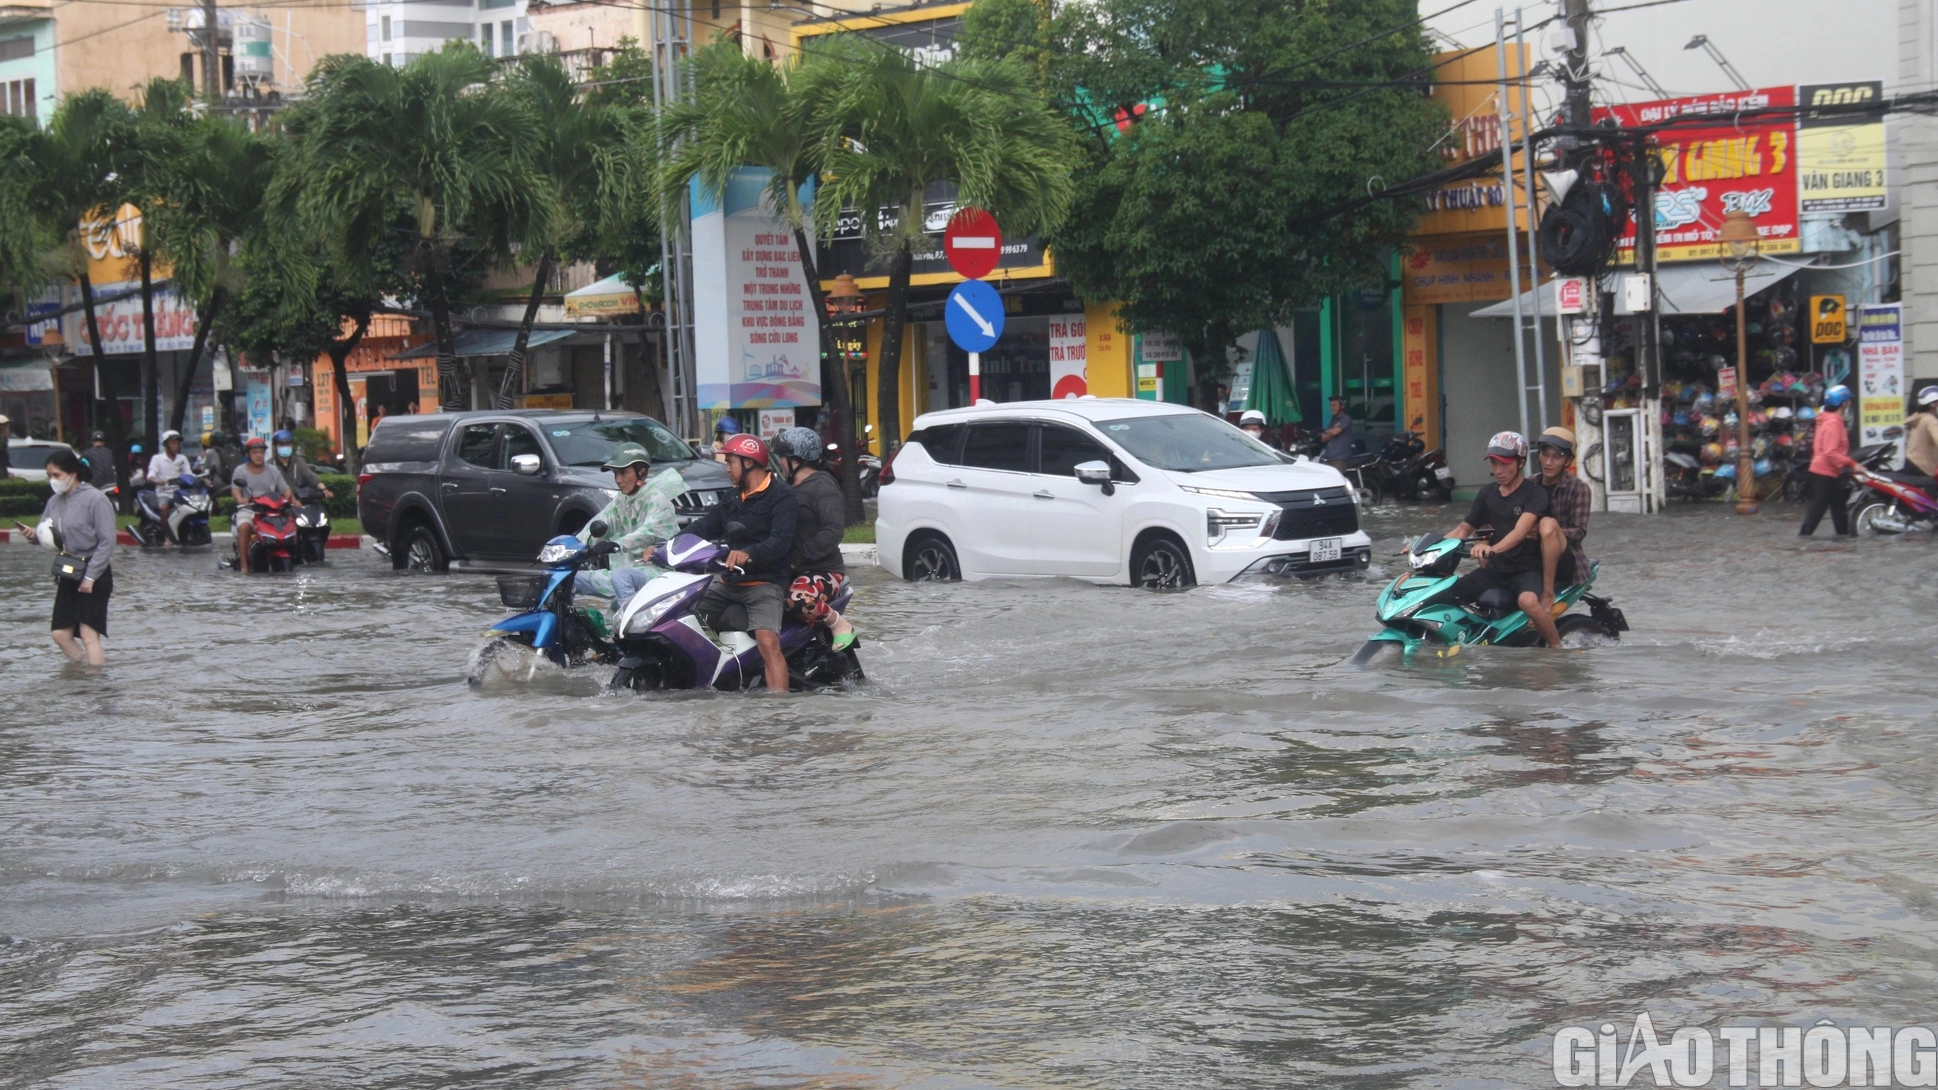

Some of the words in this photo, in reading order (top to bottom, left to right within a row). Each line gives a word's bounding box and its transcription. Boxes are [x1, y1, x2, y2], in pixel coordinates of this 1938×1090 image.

[1686, 136, 1761, 181] GIANG
[1770, 131, 1787, 174] 3
[1832, 171, 1872, 189] GIANG
[1876, 170, 1884, 187] 3
[754, 231, 774, 246] QUYẾT
[775, 232, 789, 245] TÂM
[742, 249, 754, 261] XÂY
[755, 250, 772, 264] DỰNG
[774, 251, 786, 264] BẠC
[755, 264, 767, 278] TRỞ
[769, 265, 789, 278] THÀNH
[744, 282, 757, 297] MỘT
[758, 284, 778, 294] TRONG
[780, 282, 801, 294] NHỮNG
[743, 300, 763, 311] TRUNG
[765, 298, 778, 311] TÂM
[780, 301, 788, 311] DU
[742, 316, 754, 327] KHU
[756, 316, 768, 329] VỰC
[1050, 318, 1068, 338] TRẢ
[750, 331, 767, 344] SÔNG
[782, 333, 798, 343] LONG
[1051, 342, 1065, 361] TRẢ
[1319, 540, 1332, 550] 94A
[1313, 550, 1338, 561] 087.58
